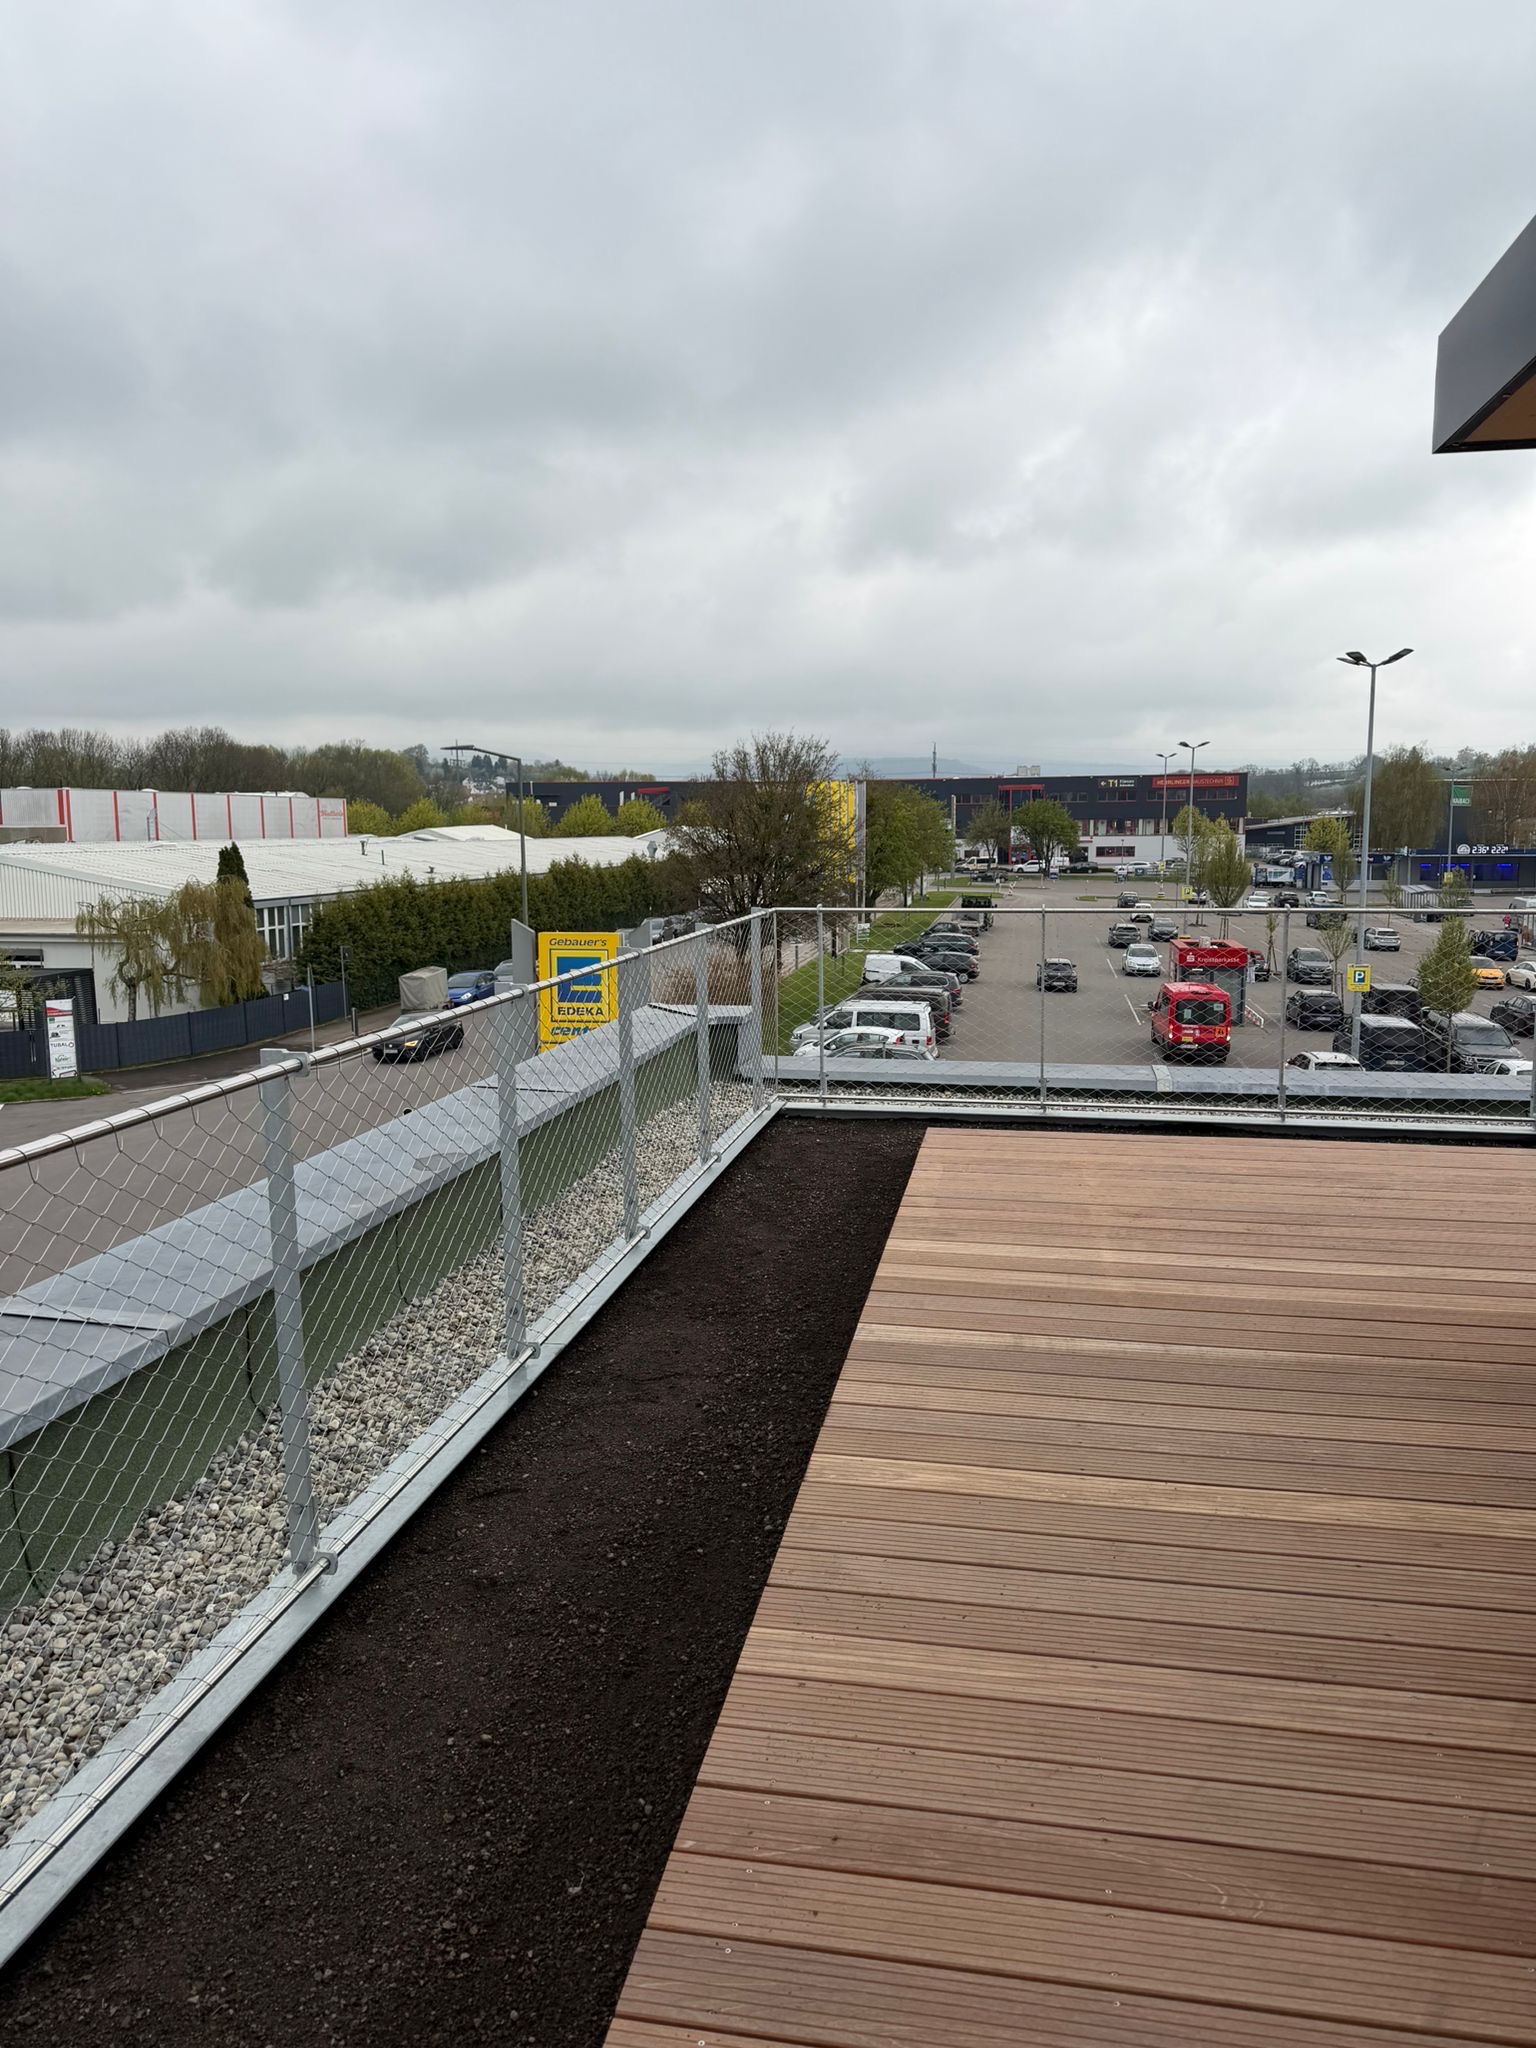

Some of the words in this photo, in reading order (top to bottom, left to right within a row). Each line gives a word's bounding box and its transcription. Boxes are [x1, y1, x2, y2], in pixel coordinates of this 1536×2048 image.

[549, 938, 607, 946] Gebauer's
[1355, 971, 1364, 982] P
[558, 1007, 603, 1015] EDEKA
